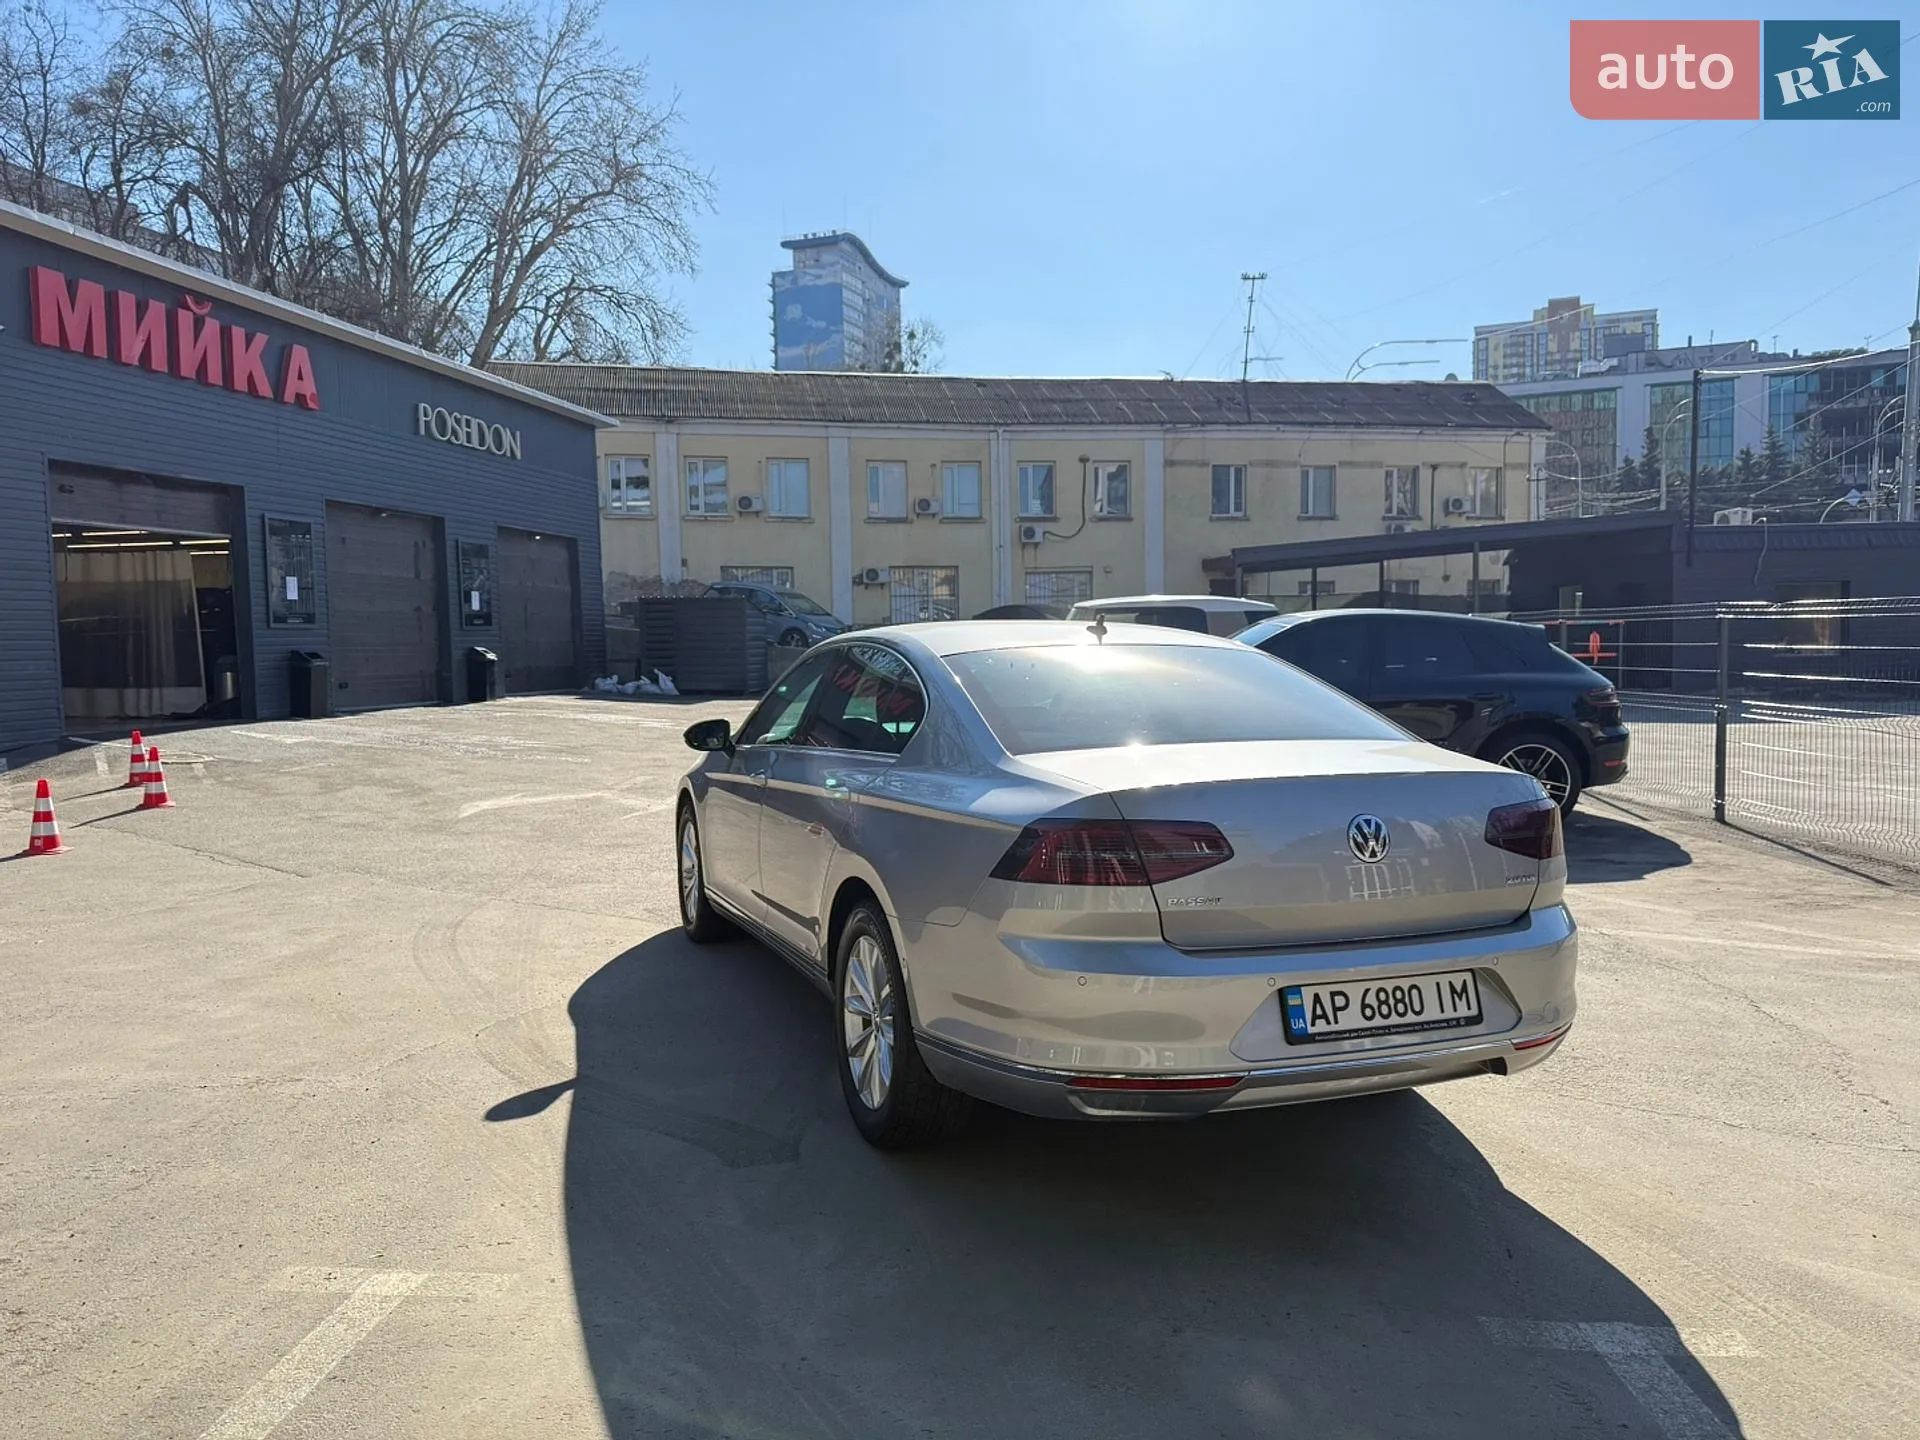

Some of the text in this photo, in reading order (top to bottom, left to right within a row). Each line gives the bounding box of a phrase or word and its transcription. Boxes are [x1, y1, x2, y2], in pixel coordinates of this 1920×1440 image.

[29, 265, 320, 410] МИЙКА
[418, 403, 521, 460] POSEIDON
[1290, 1018, 1306, 1030] UA
[1310, 979, 1472, 1027] AP 6880 IM
